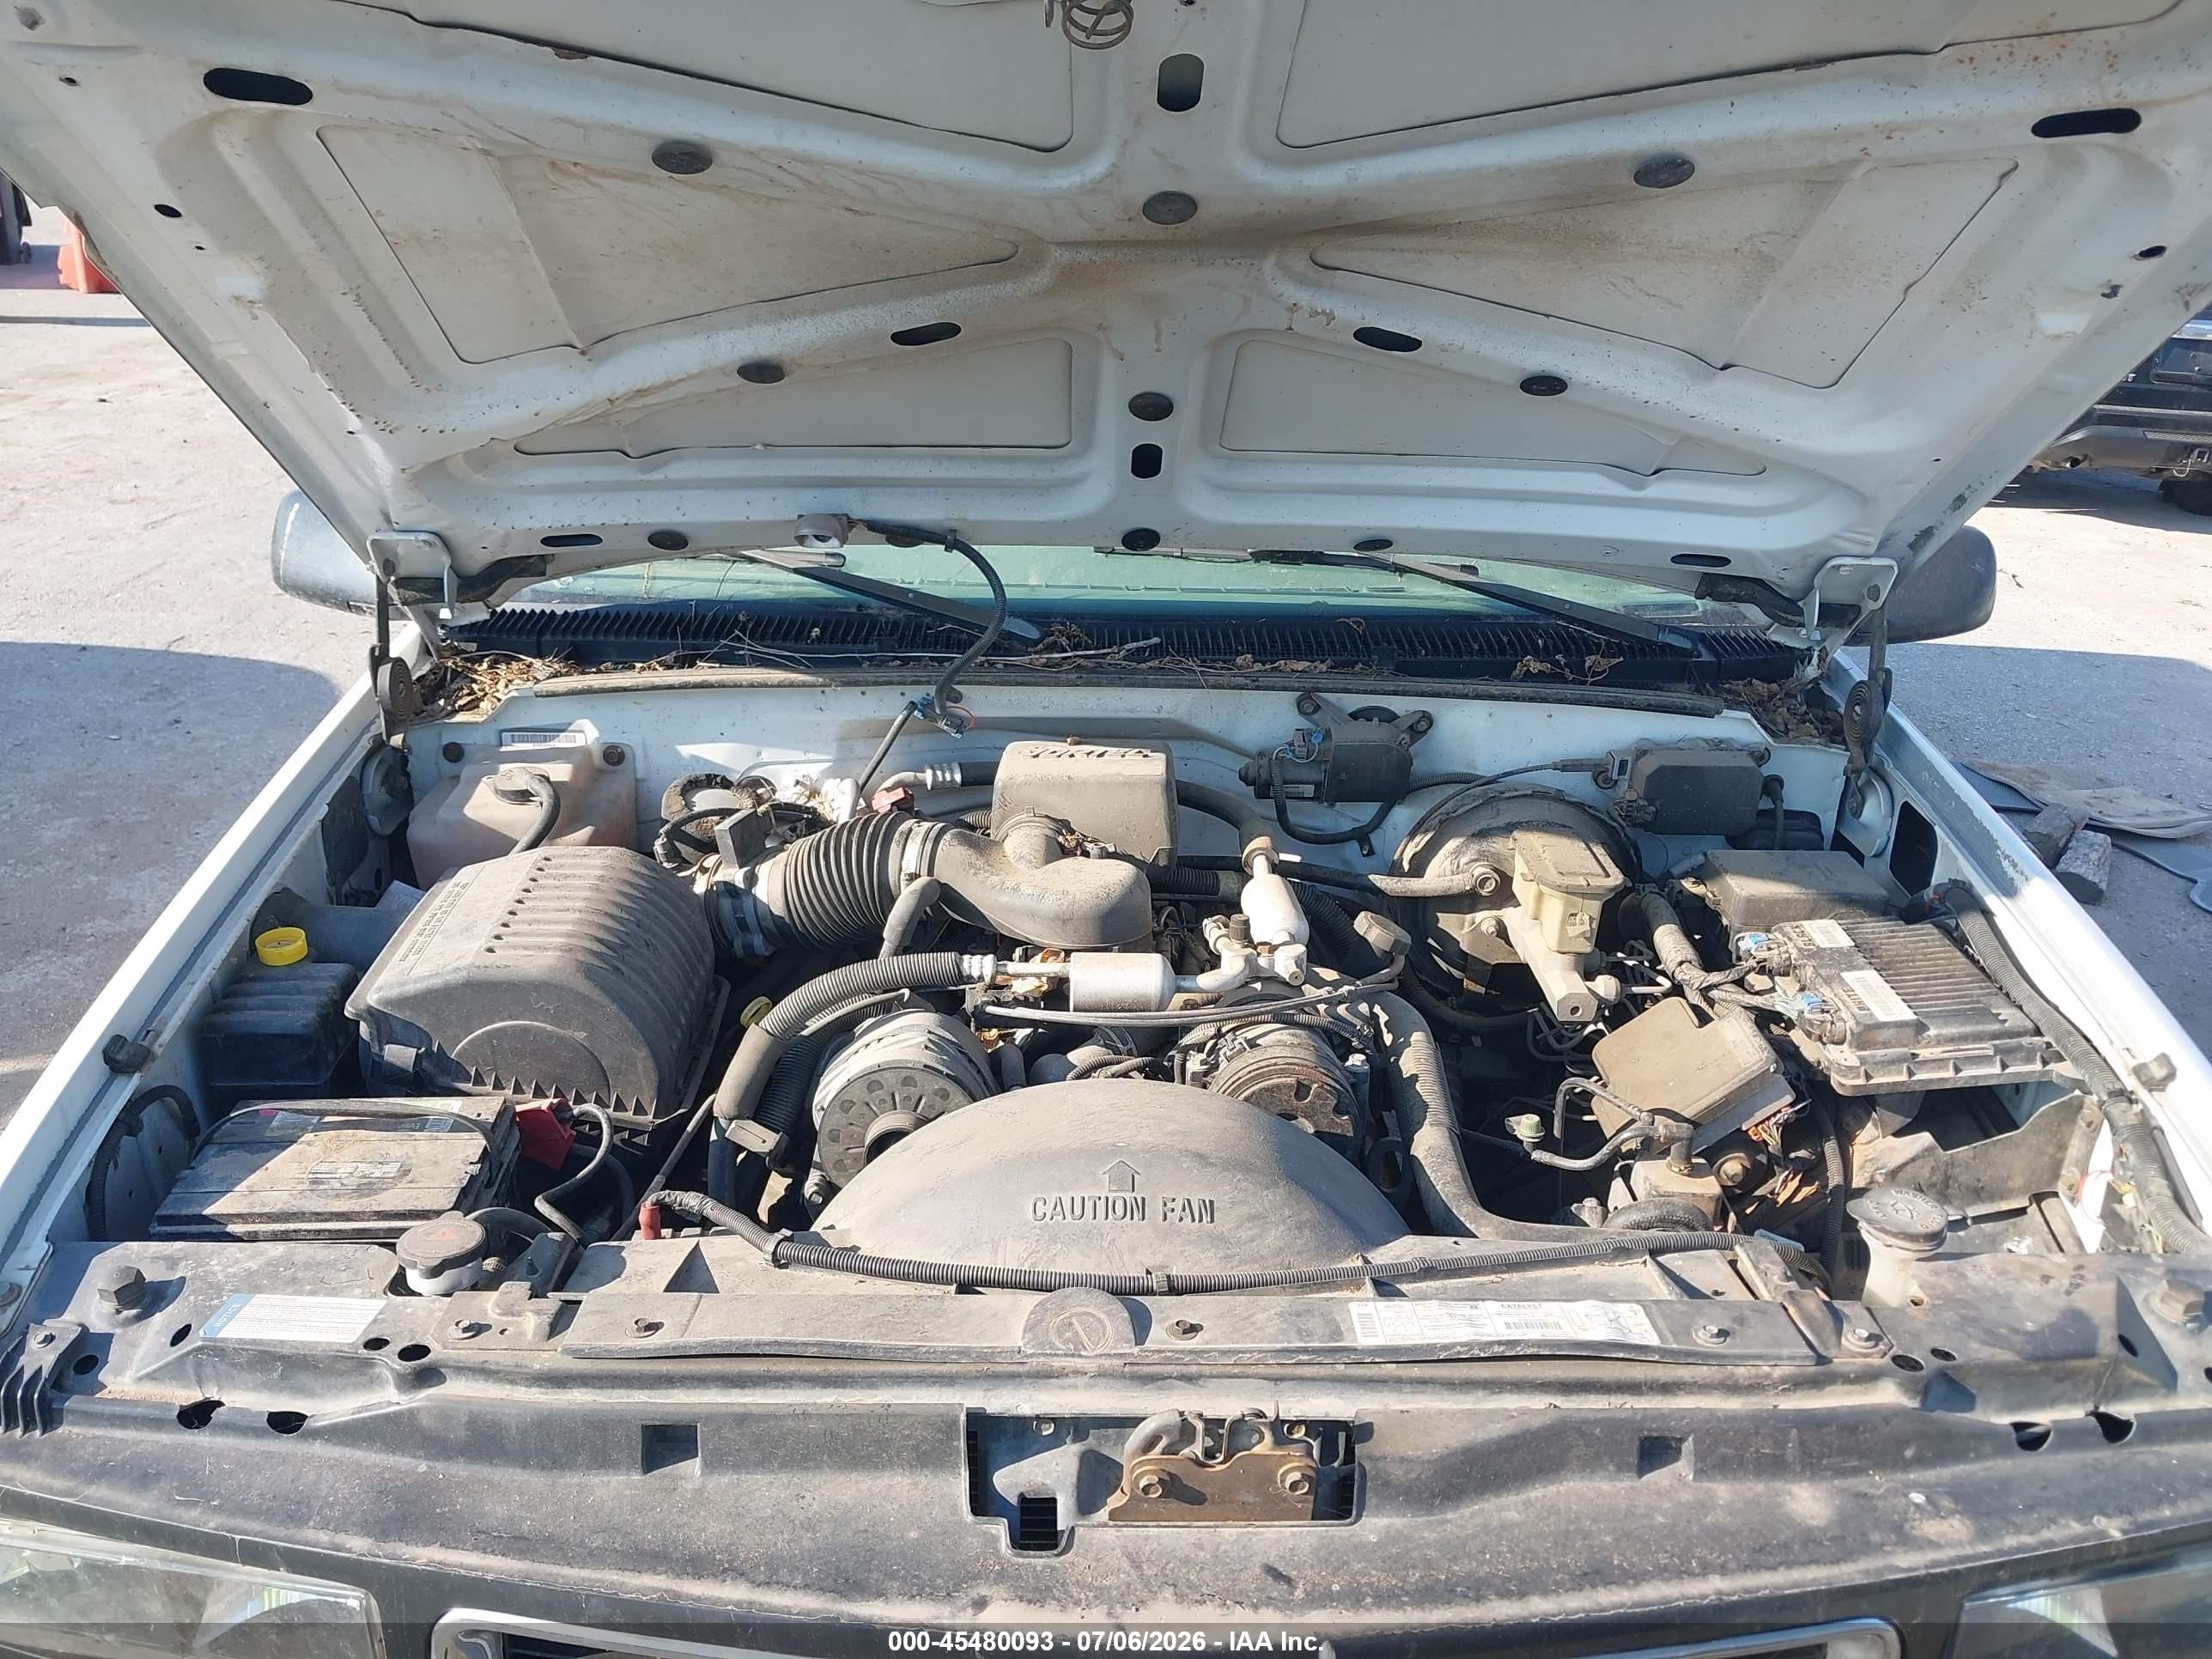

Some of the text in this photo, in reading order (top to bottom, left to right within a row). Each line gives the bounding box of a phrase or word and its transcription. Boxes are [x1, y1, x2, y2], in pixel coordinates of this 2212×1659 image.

[1030, 1195, 1216, 1224] CAUTION FAN
[1867, 1200, 1888, 1219] ONLY
[1891, 1188, 1938, 1209] WASHER
[212, 1304, 241, 1328] NOTICE
